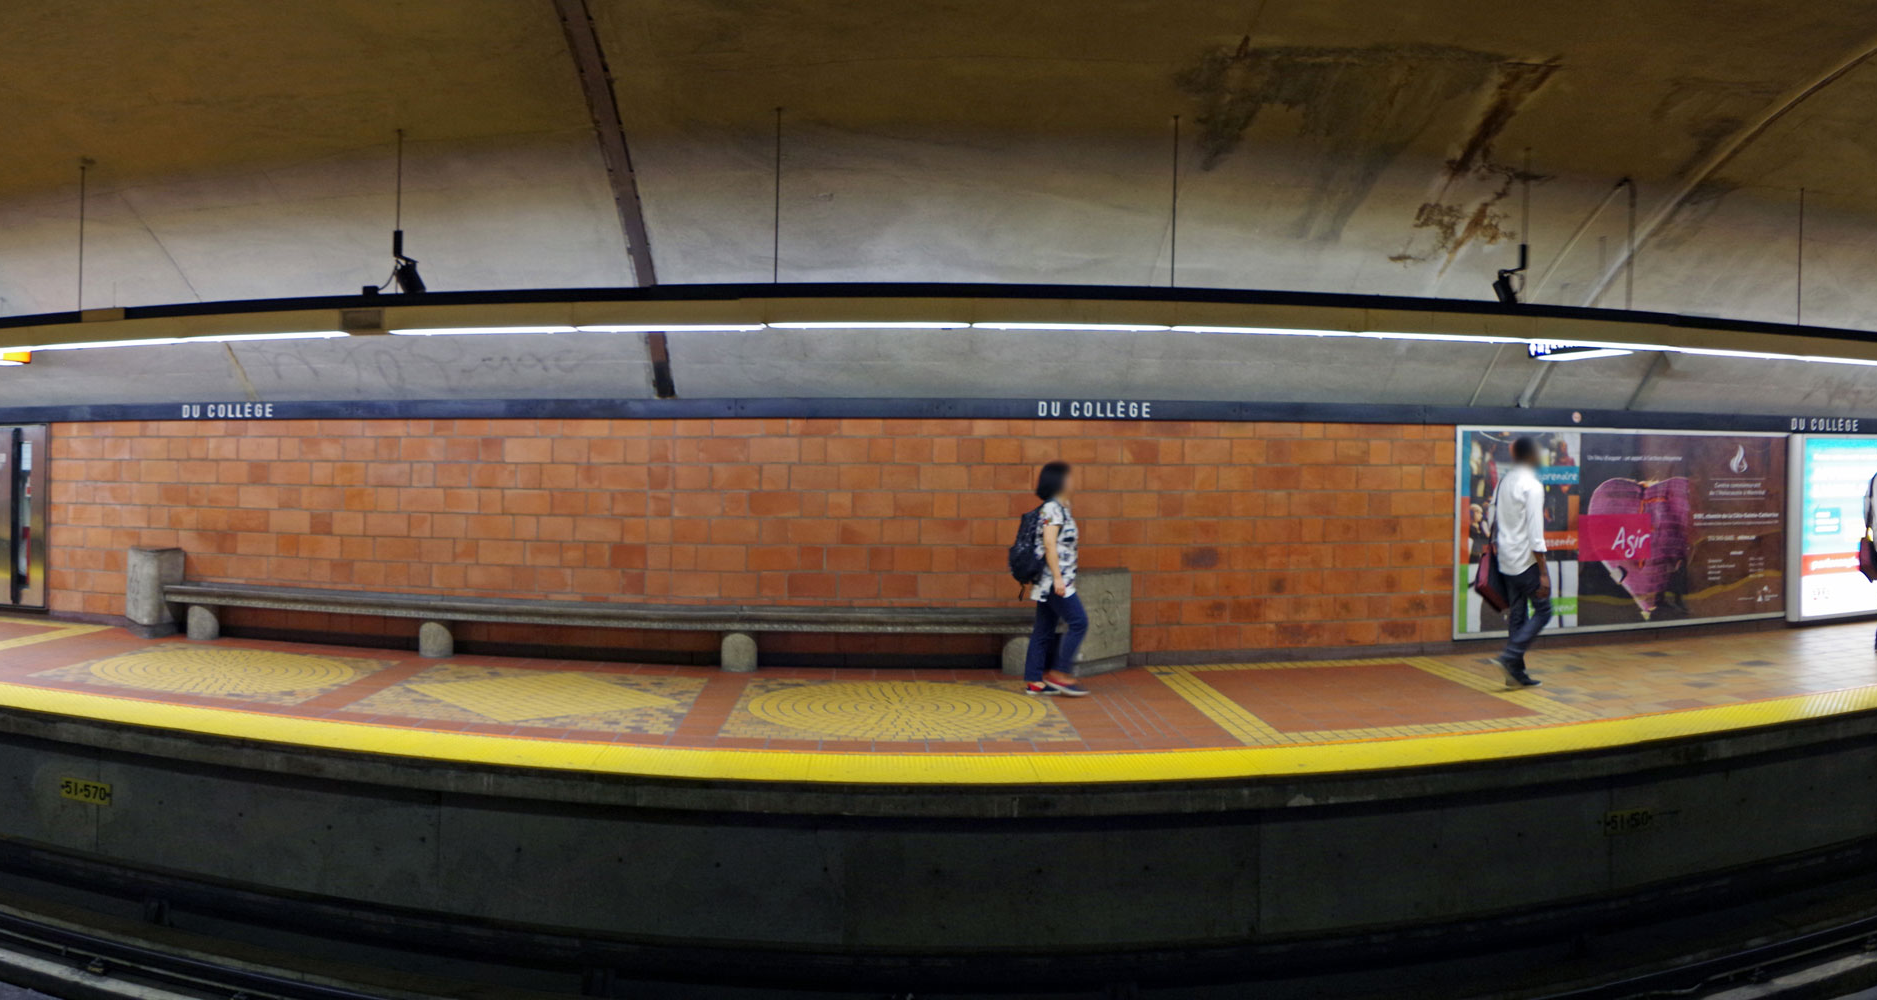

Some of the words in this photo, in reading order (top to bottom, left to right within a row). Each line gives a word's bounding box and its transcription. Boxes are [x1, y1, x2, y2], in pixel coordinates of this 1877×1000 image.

[181, 403, 201, 418] DU
[207, 402, 274, 418] COLLÈGE
[1038, 401, 1061, 417] DU
[1070, 400, 1151, 418] COLLÈGE
[1791, 418, 1806, 431] DU
[1611, 526, 1650, 558] Agir
